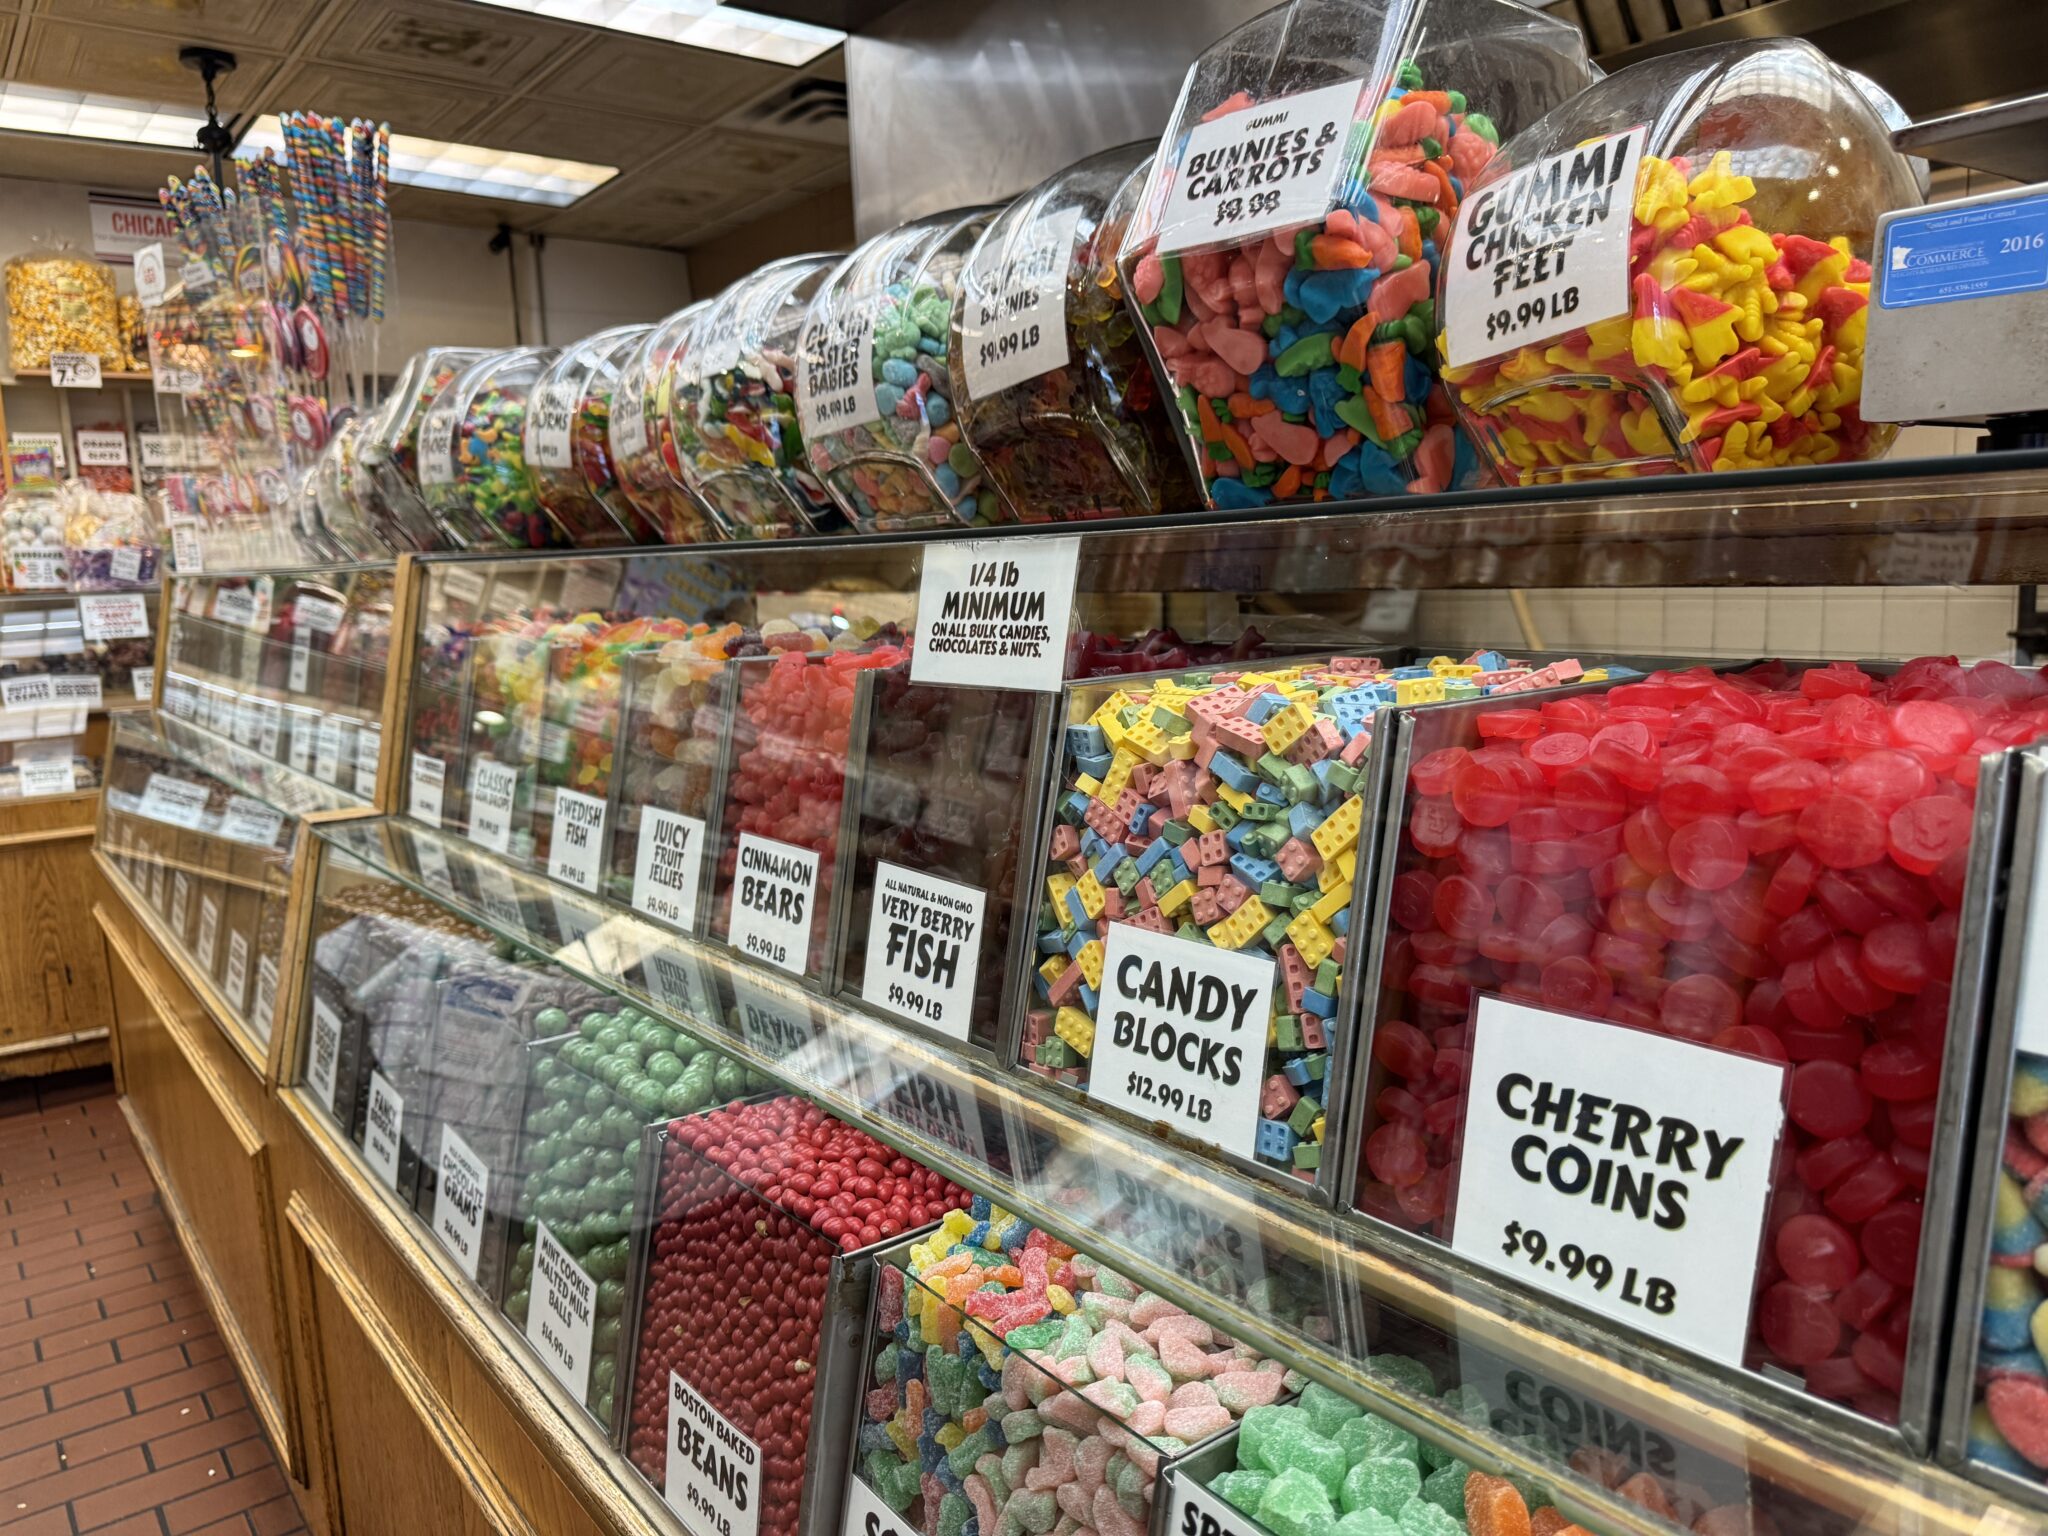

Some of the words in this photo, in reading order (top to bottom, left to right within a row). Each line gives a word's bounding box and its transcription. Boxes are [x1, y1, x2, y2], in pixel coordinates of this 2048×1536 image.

[1246, 111, 1289, 132] GUMMI
[1186, 127, 1309, 178] BUNNIES
[1315, 121, 1338, 147] &
[1187, 149, 1325, 200] CARROTS
[1468, 135, 1631, 237] GUMMI
[112, 212, 174, 238] CHICA
[1466, 184, 1613, 271] CHICKEN
[2000, 232, 2045, 253] 2016
[1493, 235, 1576, 298] FEET
[1907, 246, 1984, 268] COMMERCE
[1487, 298, 1545, 341] $9.99
[1551, 286, 1579, 319] LB
[809, 337, 860, 375] EASTER
[980, 332, 1018, 367] $9.99
[1022, 324, 1040, 351] LB
[809, 361, 859, 398] BABIES
[844, 395, 856, 415] LB
[970, 561, 997, 587] 1/4
[999, 561, 1019, 587] lb
[942, 591, 1045, 622] MINIMUM
[929, 638, 997, 655] CHOCOLATES
[999, 641, 1008, 655] &
[1010, 642, 1042, 658] NUTS.
[932, 622, 948, 637] ON
[949, 623, 967, 638] ALL
[969, 624, 998, 639] BULK
[999, 624, 1051, 643] CANDIES,
[478, 768, 512, 797] CLASSIC
[558, 796, 602, 828] SWEDISH
[565, 822, 588, 848] FISH
[654, 819, 691, 850] JUICY
[577, 870, 585, 885] LB
[649, 863, 684, 891] JELLIES
[654, 845, 685, 870] FRUIT
[741, 846, 812, 887] CINNAMON
[647, 895, 668, 917] $9.99
[669, 904, 680, 921] LB
[741, 876, 805, 925] BEARS
[885, 878, 897, 891] ALL
[898, 882, 929, 903] NATURAL
[930, 892, 936, 903] &
[937, 894, 953, 908] NON
[954, 900, 973, 915] GMO
[882, 893, 920, 924] VERY
[920, 906, 975, 942] BERRY
[746, 933, 773, 959] $9.99
[773, 944, 786, 963] LB
[886, 922, 961, 989] FISH
[888, 982, 924, 1014] $9.99
[924, 998, 943, 1021] LB
[1117, 954, 1258, 1032] CANDY
[1113, 1011, 1243, 1086] BLOCKS
[375, 1089, 397, 1128] FANCY
[1127, 1071, 1184, 1112] $12.99
[1186, 1094, 1212, 1122] LB
[1496, 1072, 1745, 1180] CHERRY
[443, 1154, 484, 1210] CHOCOLATE
[444, 1175, 477, 1228] GRAMS
[1511, 1134, 1689, 1231] COINS
[461, 1238, 468, 1257] LB
[1501, 1220, 1613, 1291] $9.99
[1619, 1267, 1677, 1315] LB
[541, 1236, 559, 1264] MINT
[560, 1257, 590, 1303] COOKIE
[538, 1254, 569, 1298] MALTED
[569, 1290, 589, 1327] MILK
[547, 1289, 572, 1329] BALLS
[542, 1321, 564, 1359] $14.99
[564, 1348, 574, 1371] LB
[675, 1382, 715, 1432] BOSTON
[716, 1420, 755, 1465] BAKED
[677, 1417, 748, 1512] BEANS
[687, 1482, 715, 1525] $9.99
[717, 1513, 730, 1536] LB
